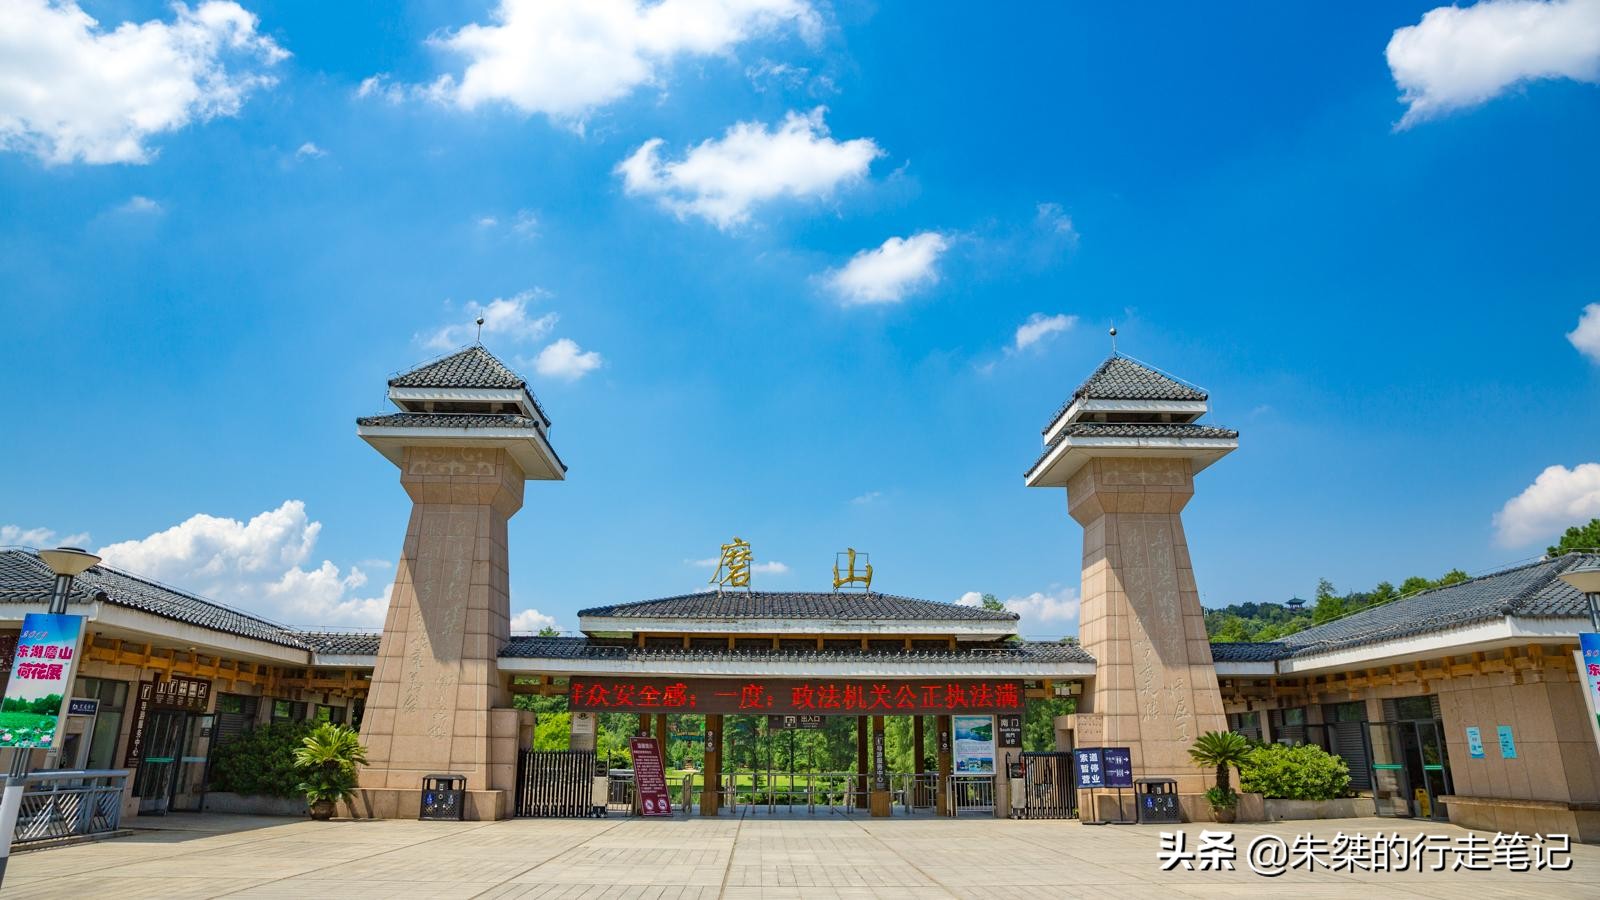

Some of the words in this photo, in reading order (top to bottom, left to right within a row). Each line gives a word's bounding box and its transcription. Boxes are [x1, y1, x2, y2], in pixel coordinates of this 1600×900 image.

[708, 536, 873, 589] 磨山
[17, 644, 73, 661] 东湖磨山
[17, 662, 63, 680] 荷花展
[800, 715, 820, 723] 出入口
[1000, 718, 1019, 727] 南门
[1079, 752, 1098, 763] 索道
[1080, 763, 1099, 773] 暂停
[1081, 774, 1101, 784] 营业
